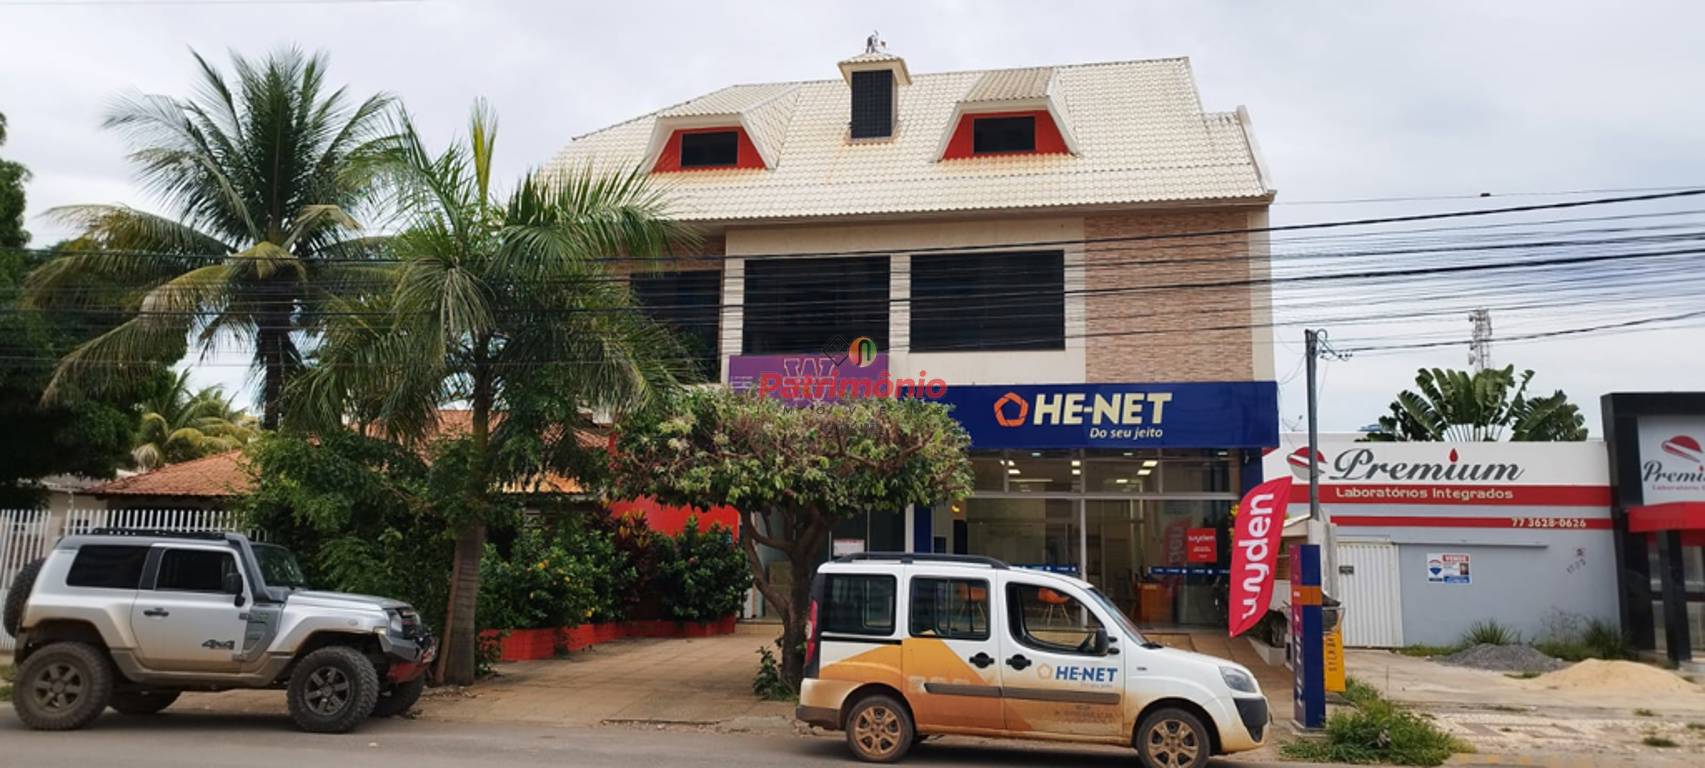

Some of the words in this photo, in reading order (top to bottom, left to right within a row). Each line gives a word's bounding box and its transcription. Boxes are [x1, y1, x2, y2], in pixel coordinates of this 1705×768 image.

[1033, 392, 1173, 426] HE-NET
[1089, 427, 1108, 439] Do
[1110, 430, 1132, 439] seu
[1132, 427, 1164, 440] jeito
[1329, 447, 1525, 481] Premium
[1643, 460, 1705, 482] Premi
[1336, 486, 1428, 499] Laboratórios
[1432, 487, 1514, 500] Integrados
[1511, 517, 1525, 528] 77
[1527, 517, 1587, 529] 3628-0626
[1056, 665, 1118, 682] HE-NET
